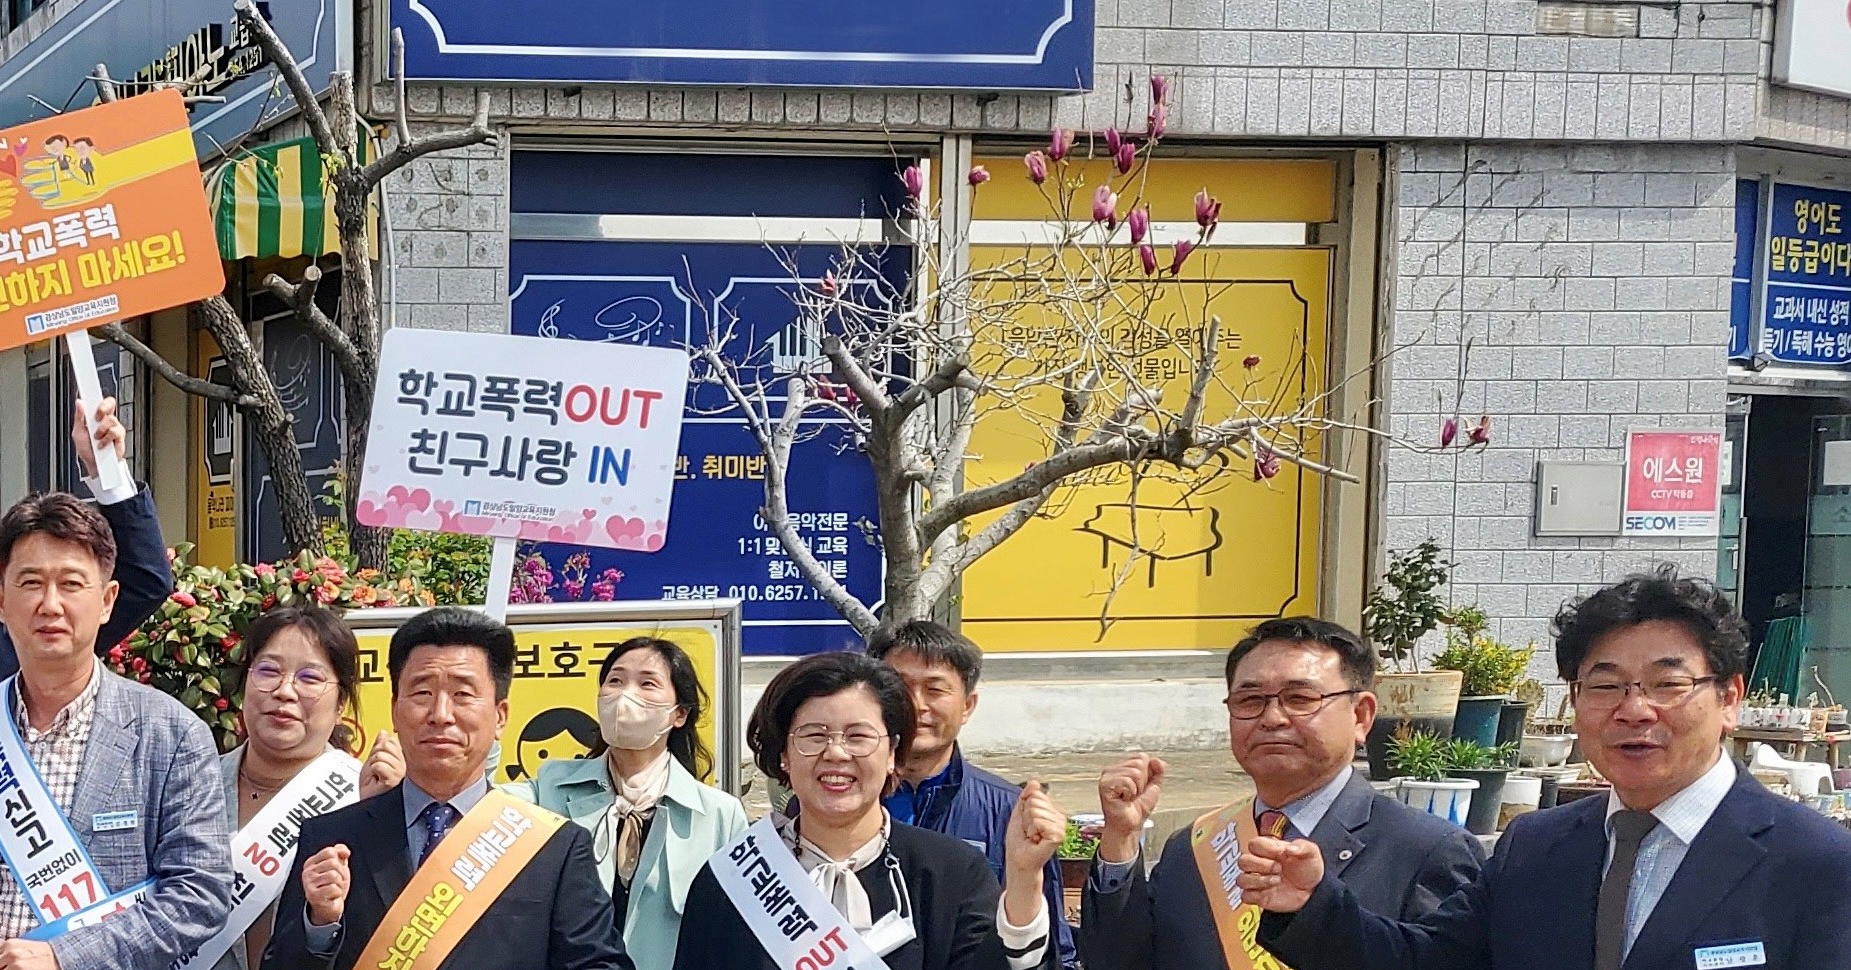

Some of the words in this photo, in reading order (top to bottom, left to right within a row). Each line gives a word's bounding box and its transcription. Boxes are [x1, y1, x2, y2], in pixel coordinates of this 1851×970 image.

[1794, 199, 1842, 236] 영어도
[78, 230, 186, 291] 마세요!
[1773, 296, 1805, 323] 교과서
[1807, 298, 1828, 324] 내신
[1829, 300, 1850, 326] 성적
[1764, 327, 1784, 355] 듣기
[1792, 329, 1813, 356] 독해
[1814, 331, 1836, 358] 수능
[408, 428, 578, 486] 친구사랑
[588, 445, 631, 487] IN
[702, 454, 767, 481] 취미반
[1643, 457, 1703, 484] 에스원
[1651, 489, 1672, 499] CCTV
[1625, 516, 1676, 530] SECOM
[816, 536, 849, 555] 교육
[243, 842, 280, 877] NO
[450, 806, 535, 893] 학교폭력
[24, 848, 82, 890] 국번없이
[38, 870, 98, 921] 117
[728, 834, 819, 942] 학교폭력
